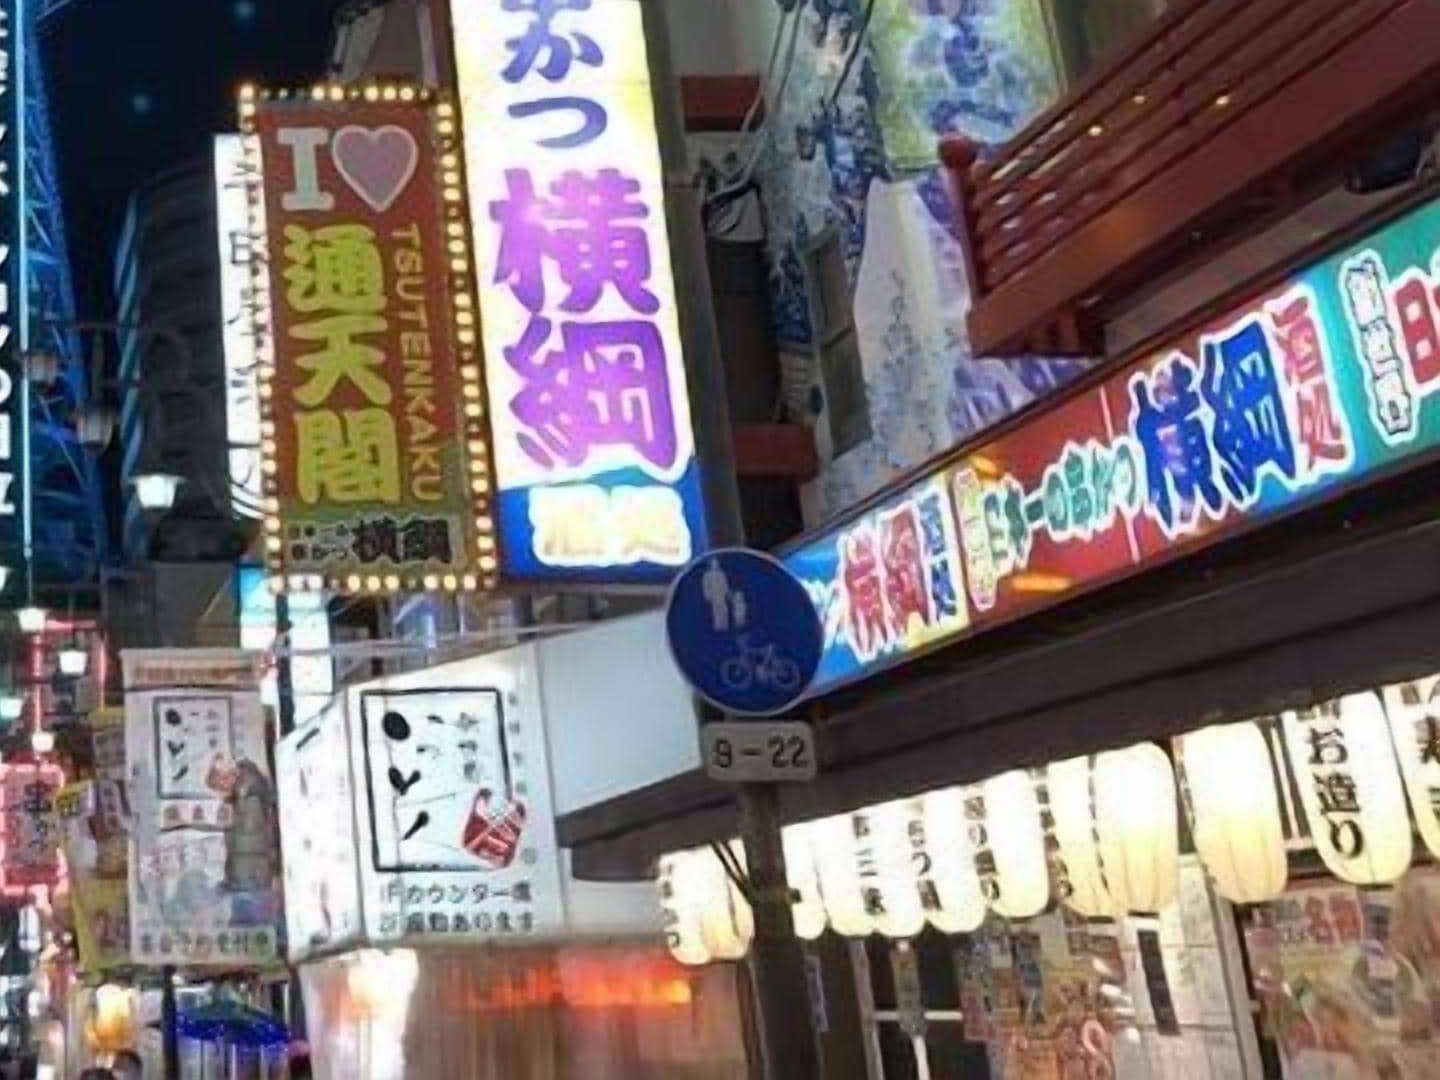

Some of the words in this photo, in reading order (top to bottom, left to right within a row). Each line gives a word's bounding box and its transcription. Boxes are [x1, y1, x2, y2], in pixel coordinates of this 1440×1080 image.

[275, 127, 334, 211] I
[282, 223, 403, 505] 通天閣
[392, 223, 444, 502] TSUTENKAKU
[488, 166, 678, 470] 横綱
[1130, 318, 1298, 531] 横綱
